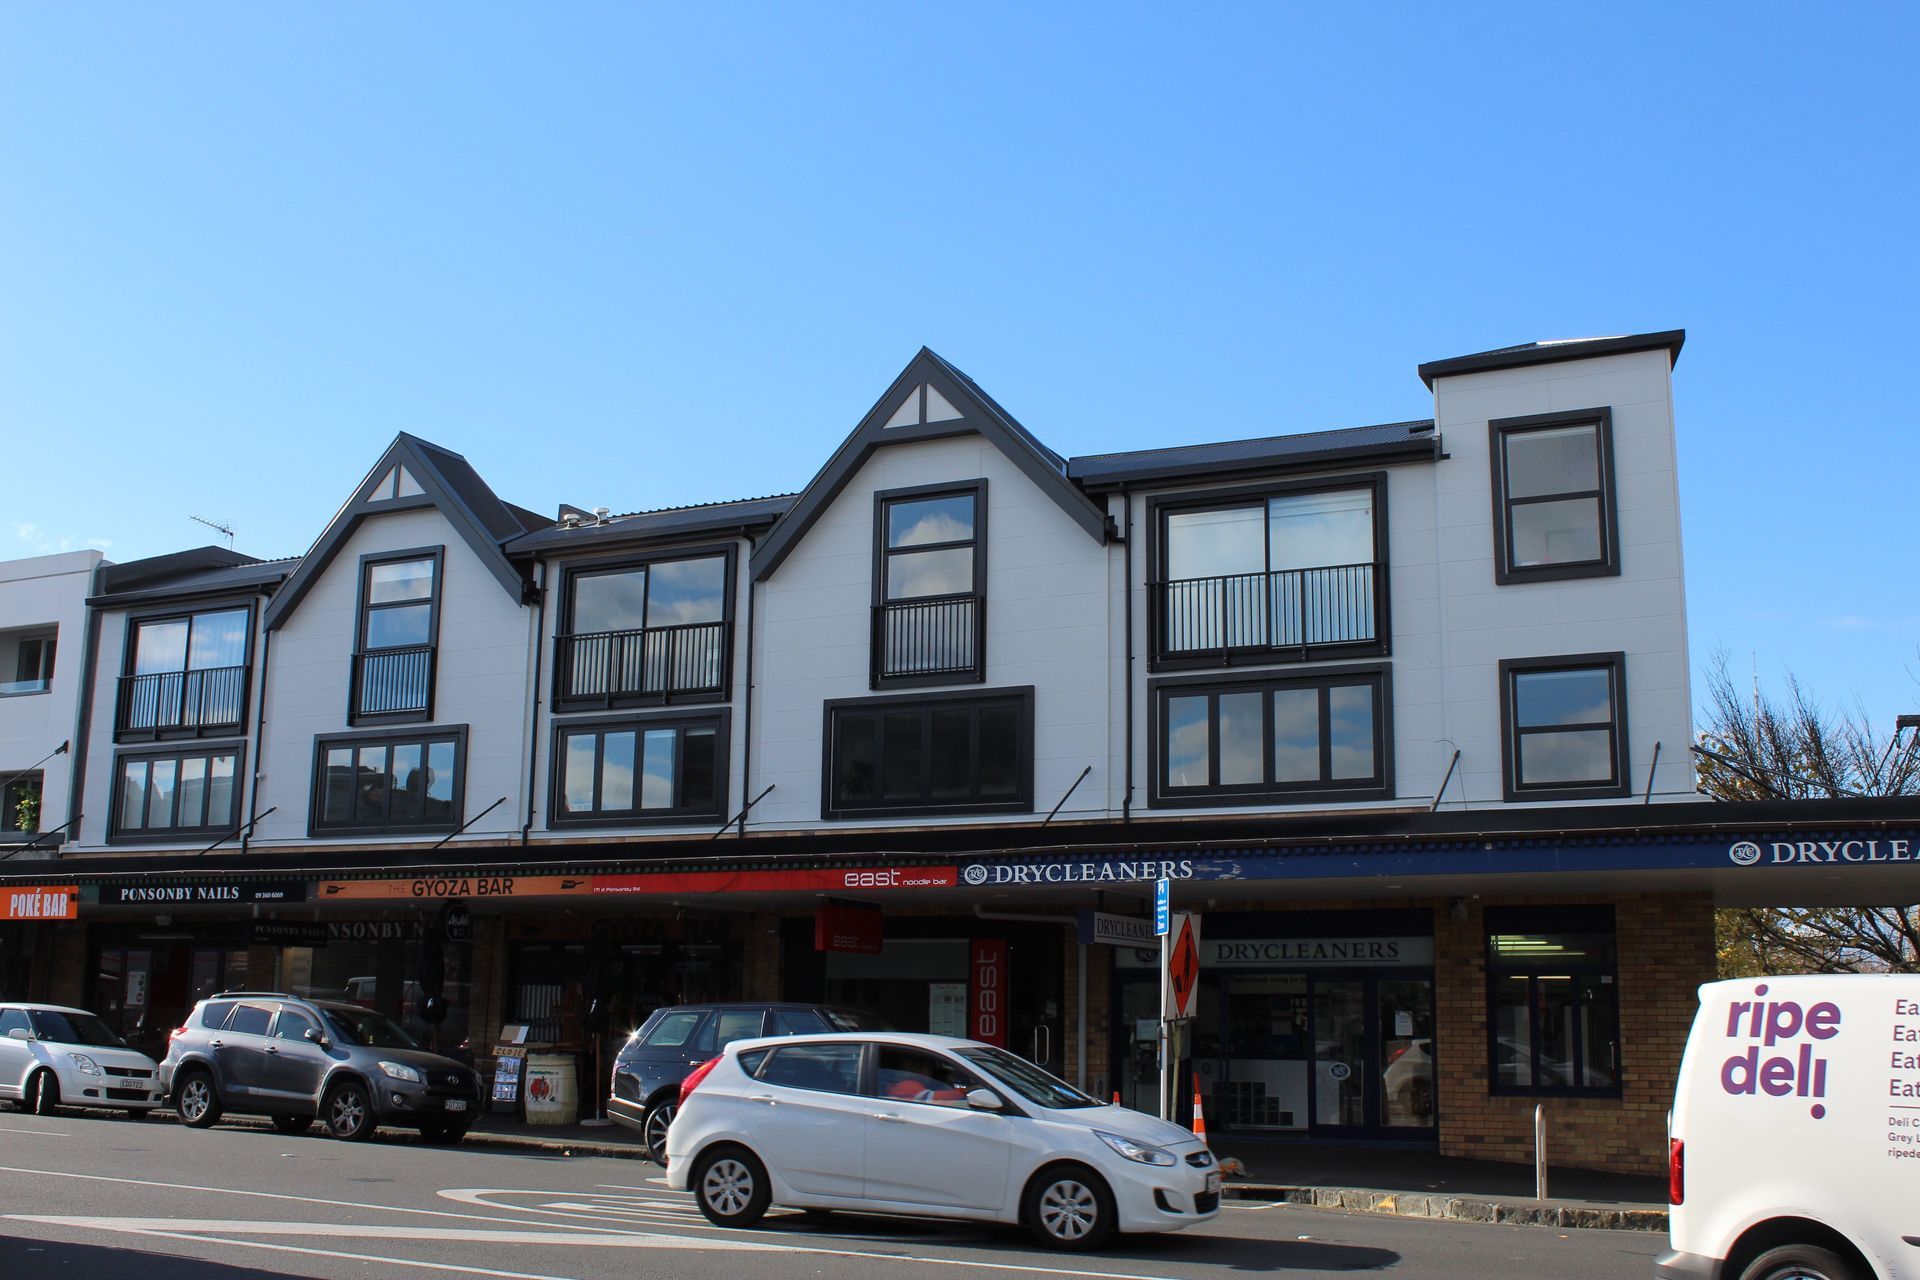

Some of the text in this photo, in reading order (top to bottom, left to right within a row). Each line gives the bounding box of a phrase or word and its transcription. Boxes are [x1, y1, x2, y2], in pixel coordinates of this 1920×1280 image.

[1770, 840, 1920, 863] DRYCLE
[844, 868, 900, 887] east
[995, 860, 1193, 883] DRYCLEANERS
[121, 886, 239, 901] PONSONBY NAILS
[388, 878, 513, 896] THE GYOZA BAR
[9, 888, 67, 918] POKÉ BAR
[832, 933, 861, 949] east
[1216, 942, 1399, 960] DRYCLEANERS
[976, 948, 997, 1037] east
[1726, 984, 1841, 1047] ripe
[1893, 1024, 1920, 1042] Ea
[496, 1047, 524, 1057] CLOSE
[1721, 1043, 1827, 1120] deli
[1889, 1078, 1920, 1097] Eat
[1888, 1117, 1909, 1127] Deli
[1888, 1132, 1913, 1144] Grey
